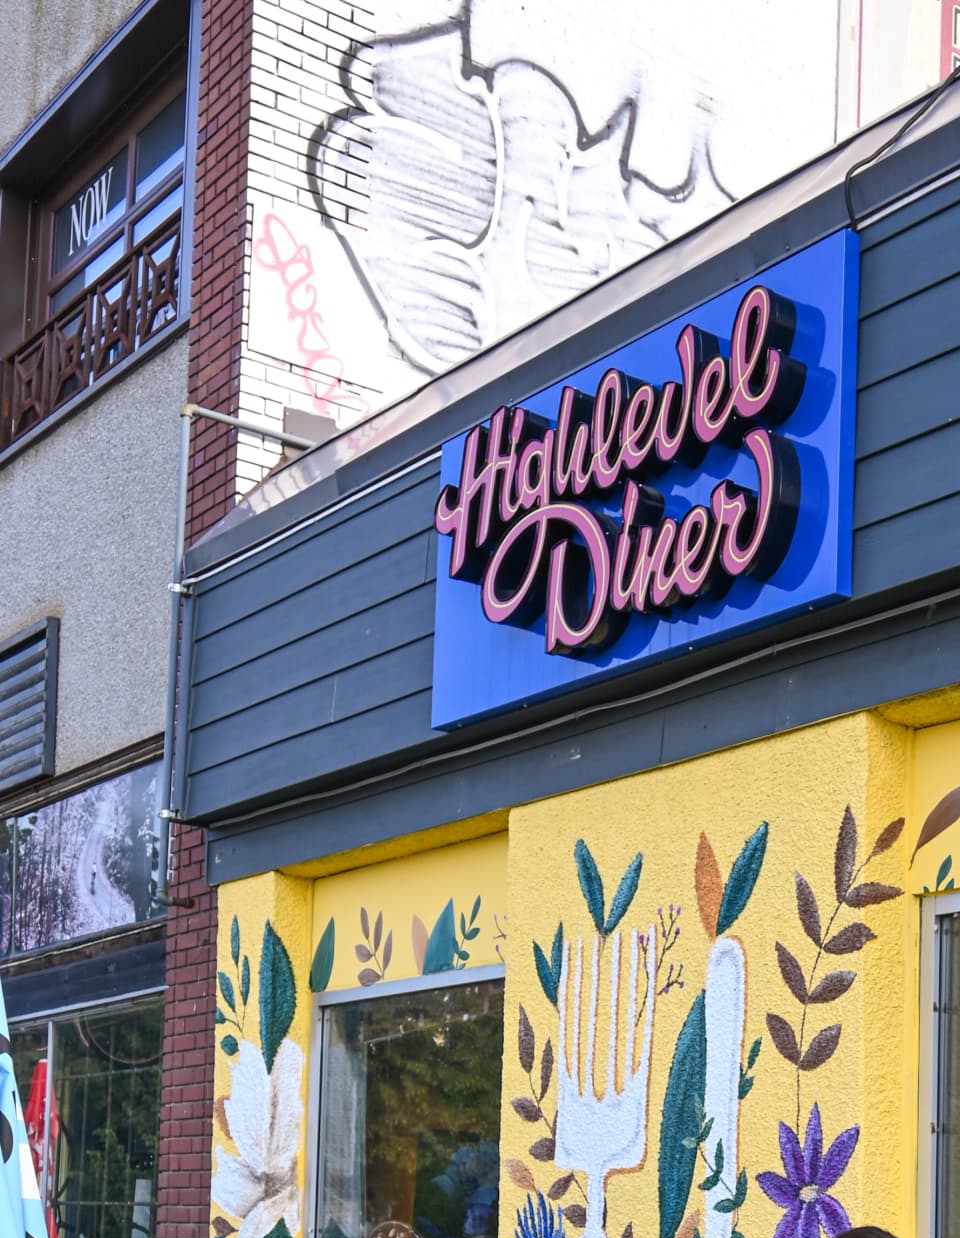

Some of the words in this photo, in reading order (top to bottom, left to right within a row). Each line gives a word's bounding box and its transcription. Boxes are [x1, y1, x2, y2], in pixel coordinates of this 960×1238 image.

[68, 166, 114, 256] NOW
[434, 284, 784, 578] Highlevel
[481, 427, 776, 653] Diner
